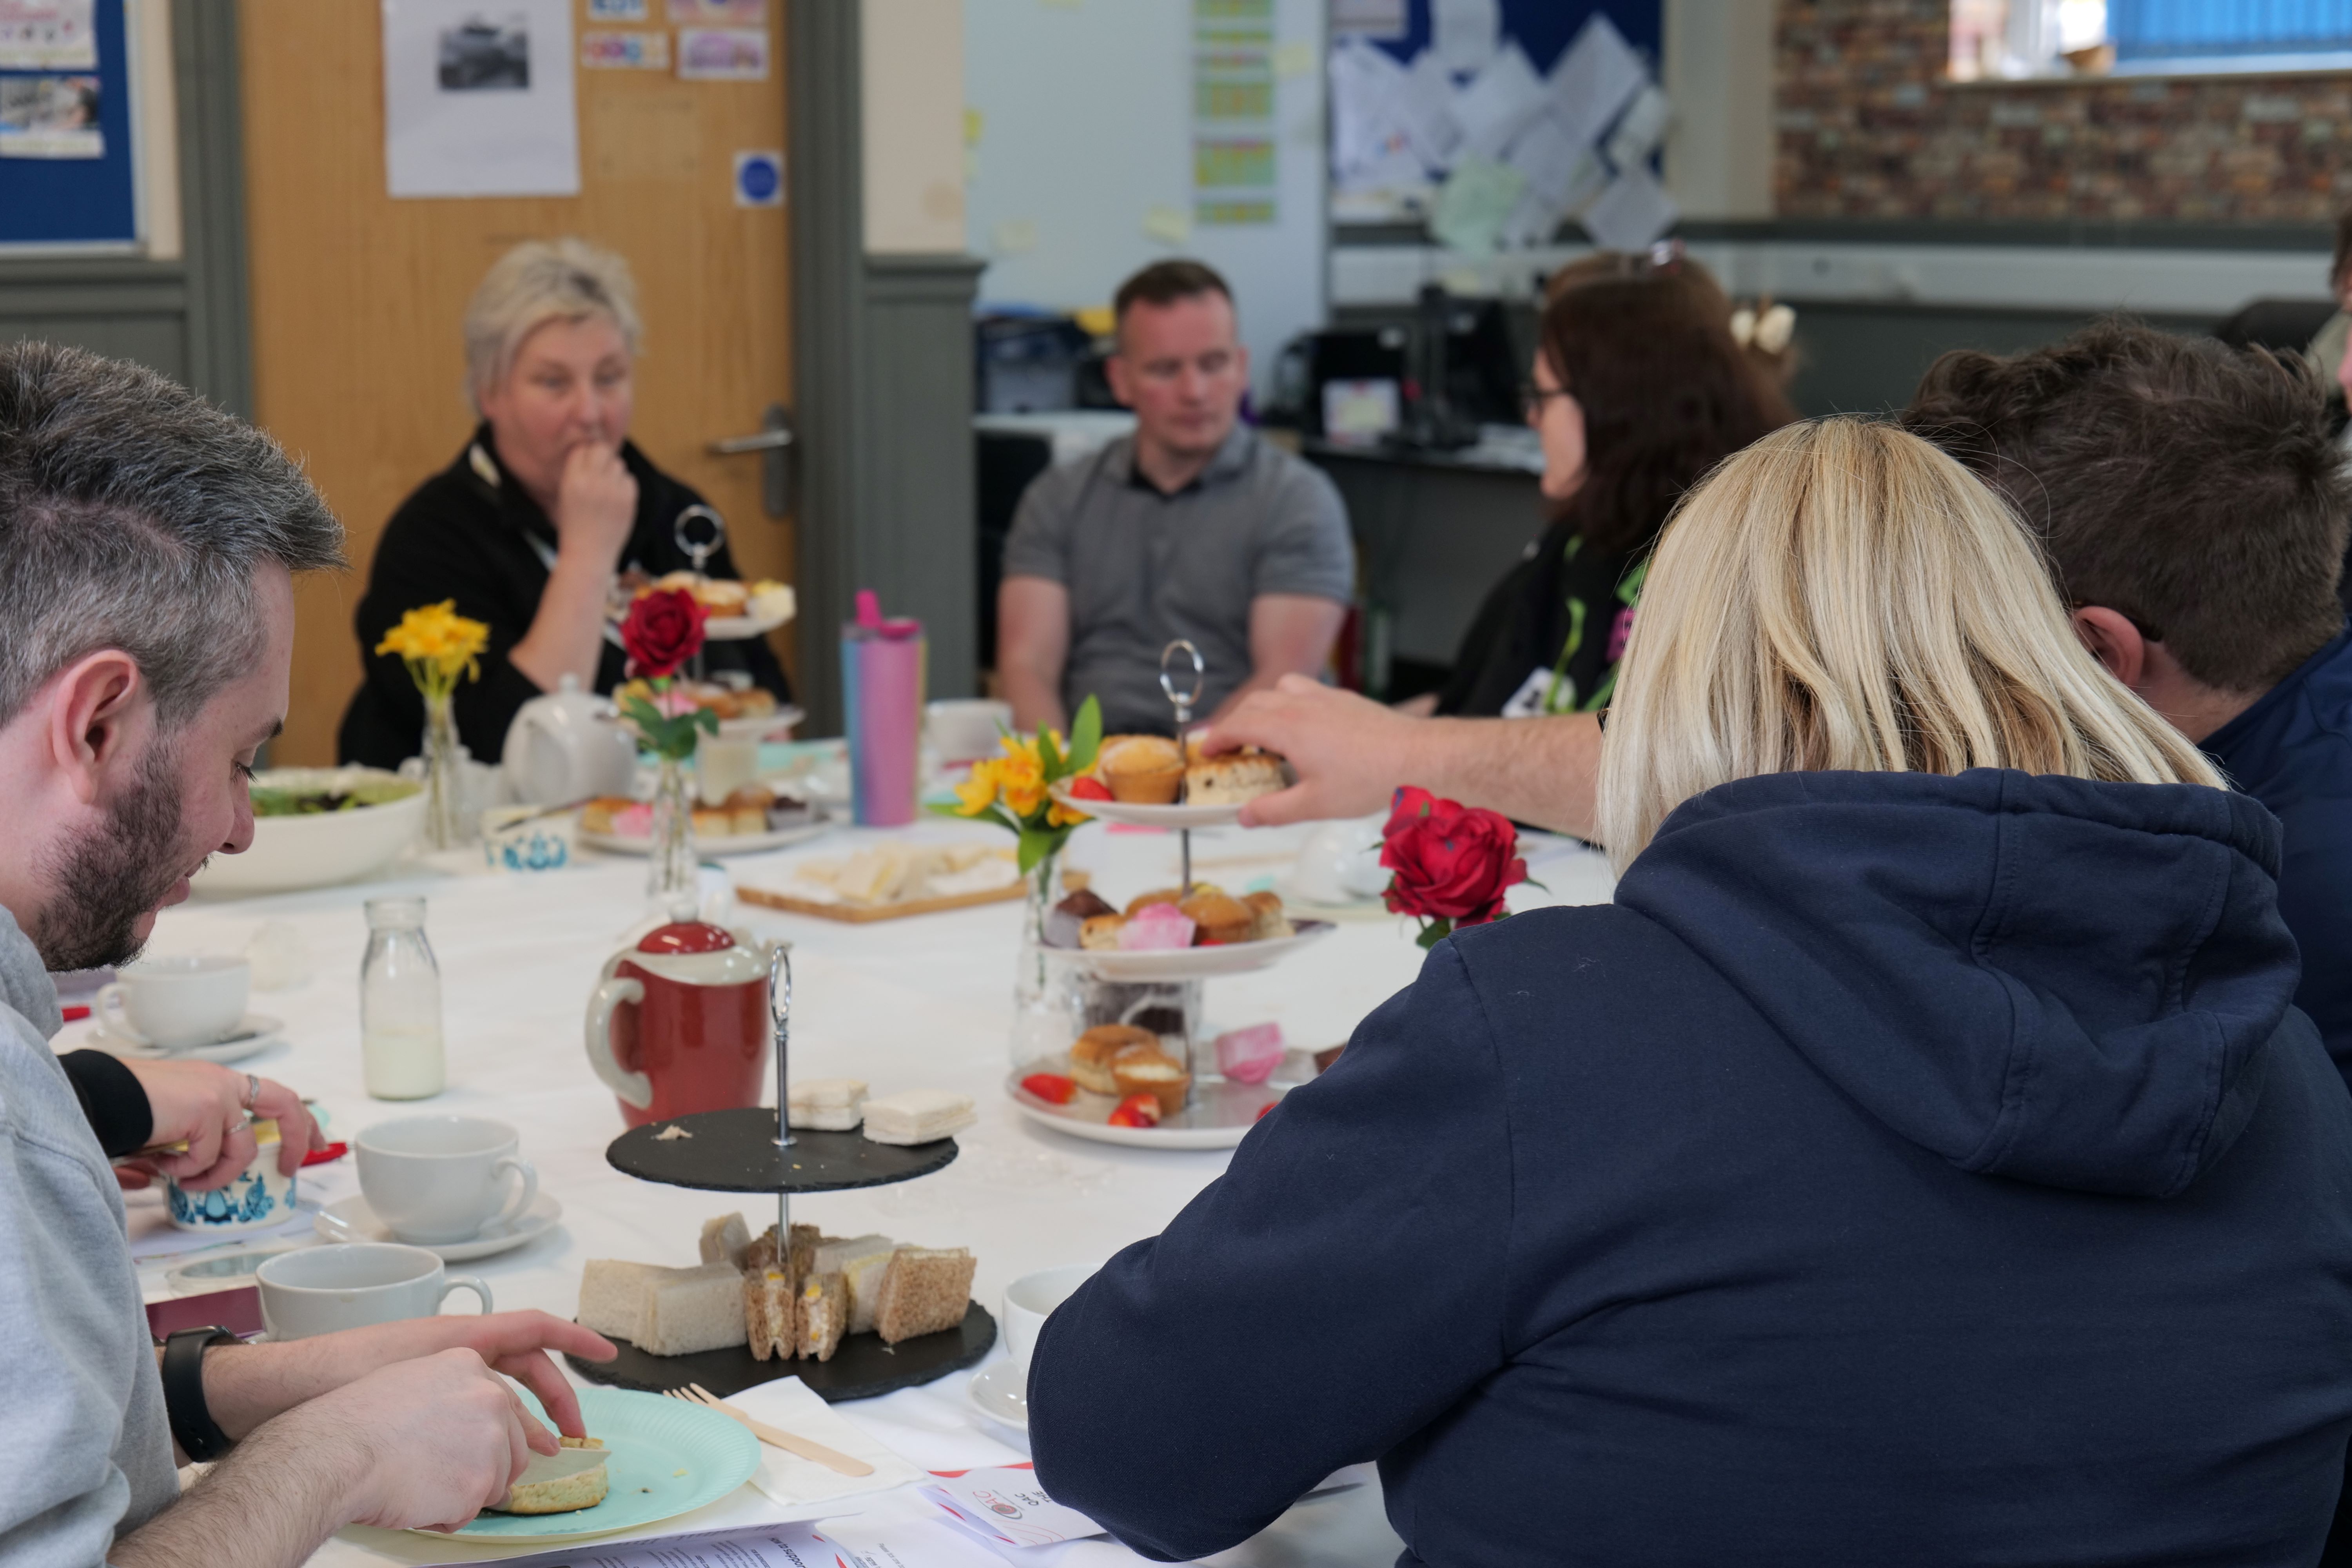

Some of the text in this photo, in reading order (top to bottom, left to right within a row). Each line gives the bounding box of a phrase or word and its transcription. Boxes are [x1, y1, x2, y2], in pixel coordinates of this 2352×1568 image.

[973, 1490, 1016, 1514] QAC
[1014, 1493, 1039, 1506] QAC
[1032, 1490, 1052, 1503] THE
[783, 1549, 808, 1568] suppor
